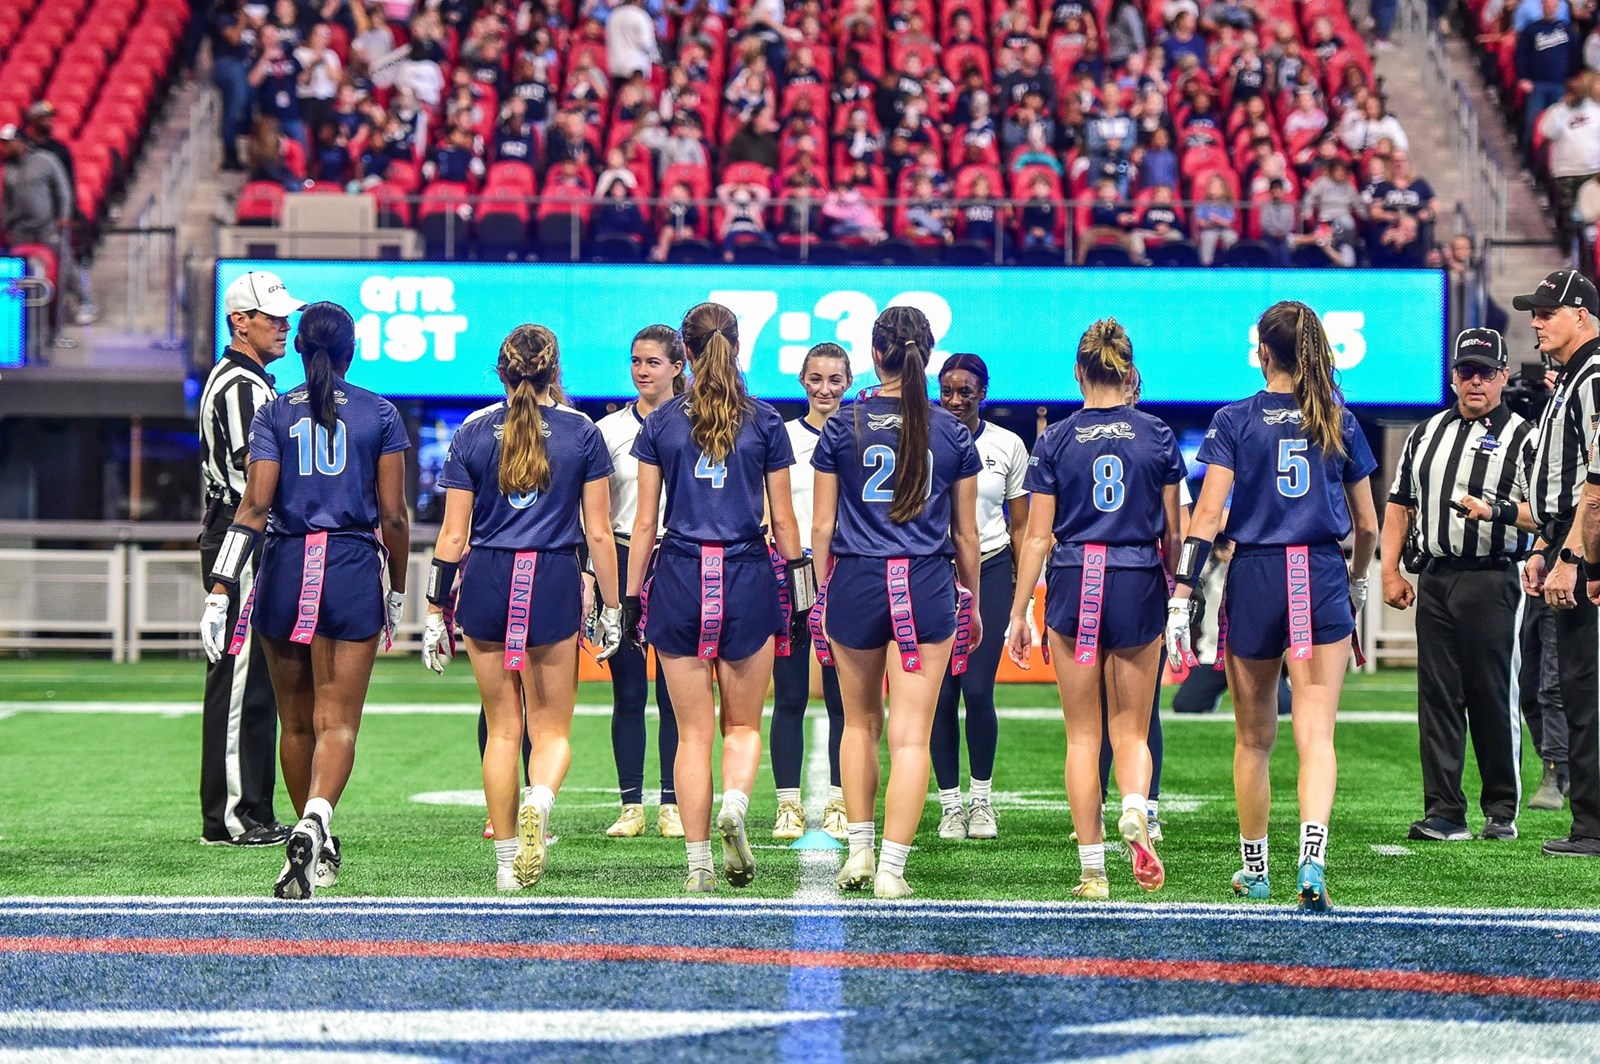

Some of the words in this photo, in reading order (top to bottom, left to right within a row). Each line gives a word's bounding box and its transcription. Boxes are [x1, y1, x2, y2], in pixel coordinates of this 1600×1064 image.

[360, 276, 455, 314] QTR
[355, 315, 467, 362] 1ST
[289, 417, 347, 476] 10
[694, 450, 728, 489] 4
[862, 444, 934, 503] 2
[1276, 438, 1311, 498] 5
[1092, 454, 1126, 513] 8
[298, 544, 326, 631] HOUNDS
[507, 558, 534, 653] HOUNDS
[701, 555, 723, 645] HOUNDS
[889, 563, 919, 655] HOUNDS
[1078, 552, 1104, 649] HOUNDS
[1290, 552, 1311, 645] HOUNDS
